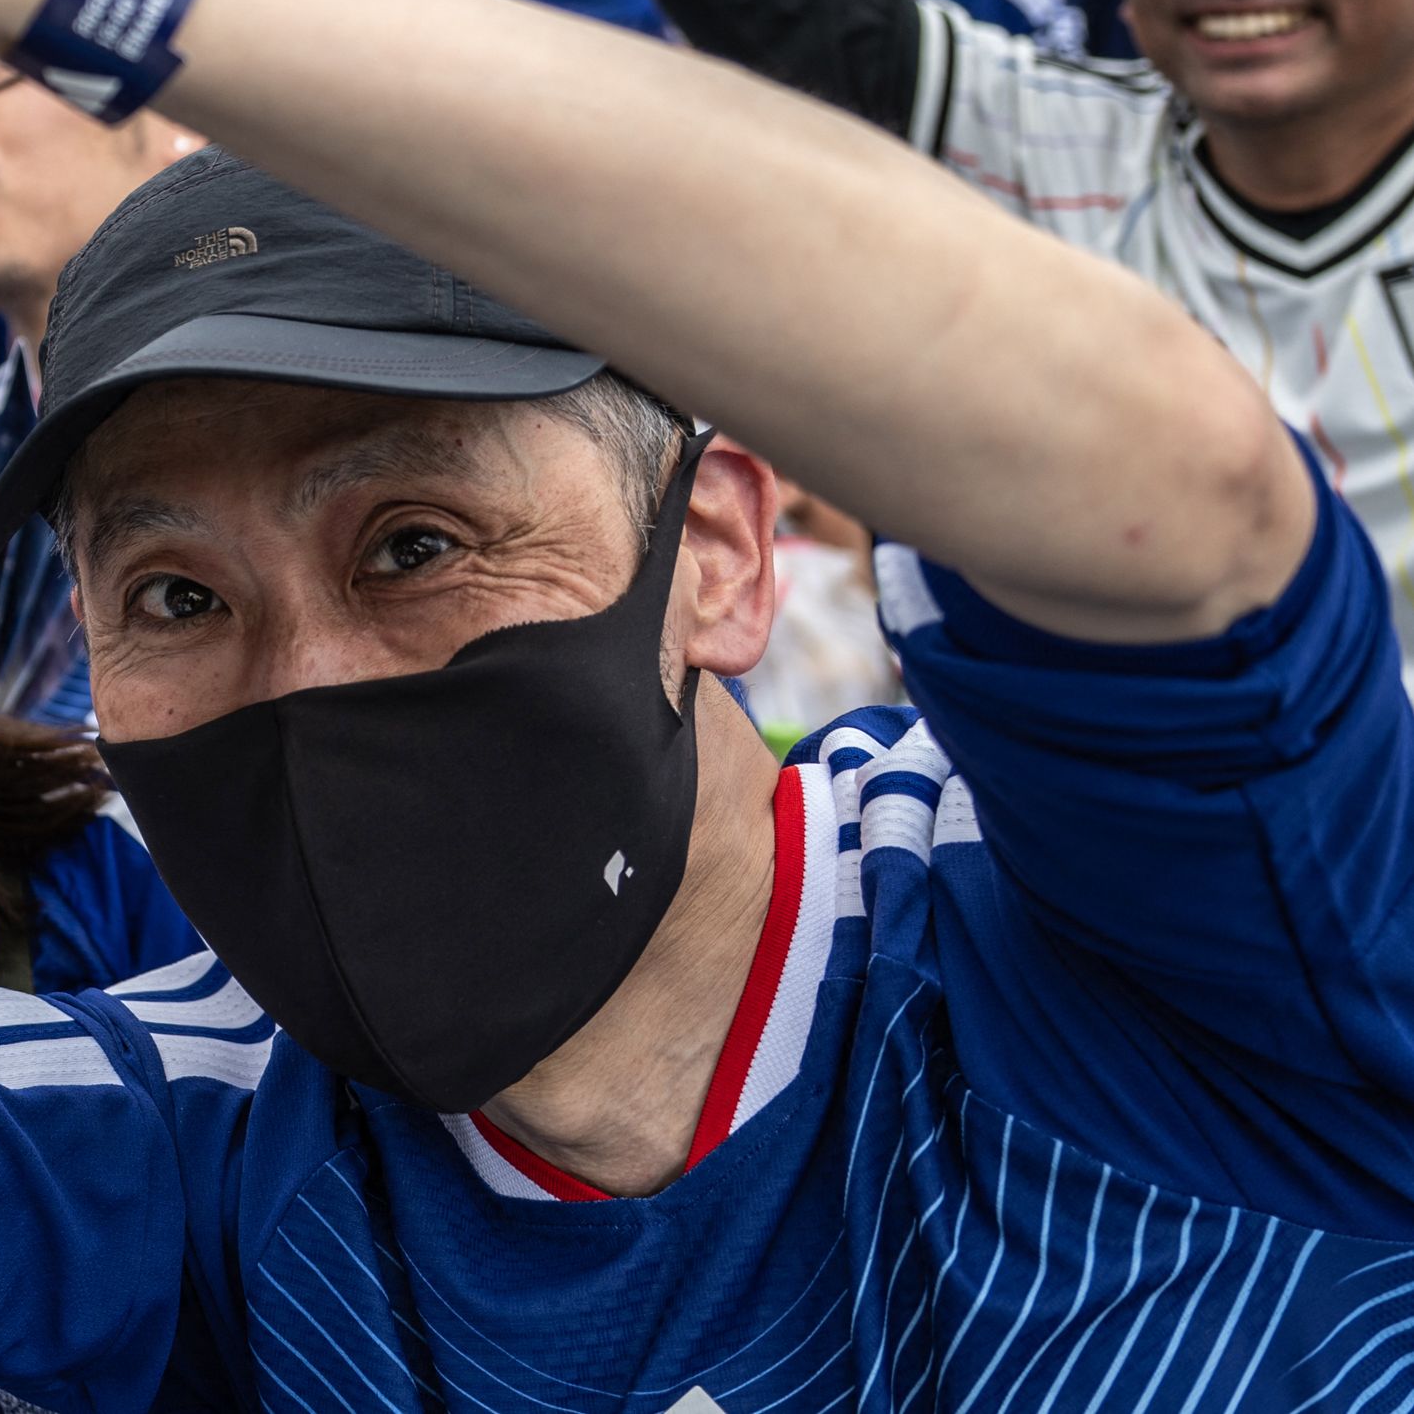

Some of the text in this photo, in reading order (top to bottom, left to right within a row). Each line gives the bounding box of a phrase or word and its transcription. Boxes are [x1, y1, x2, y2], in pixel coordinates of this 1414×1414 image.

[194, 227, 228, 245] THE
[174, 239, 228, 268] NORTH
[189, 250, 228, 270] FACE
